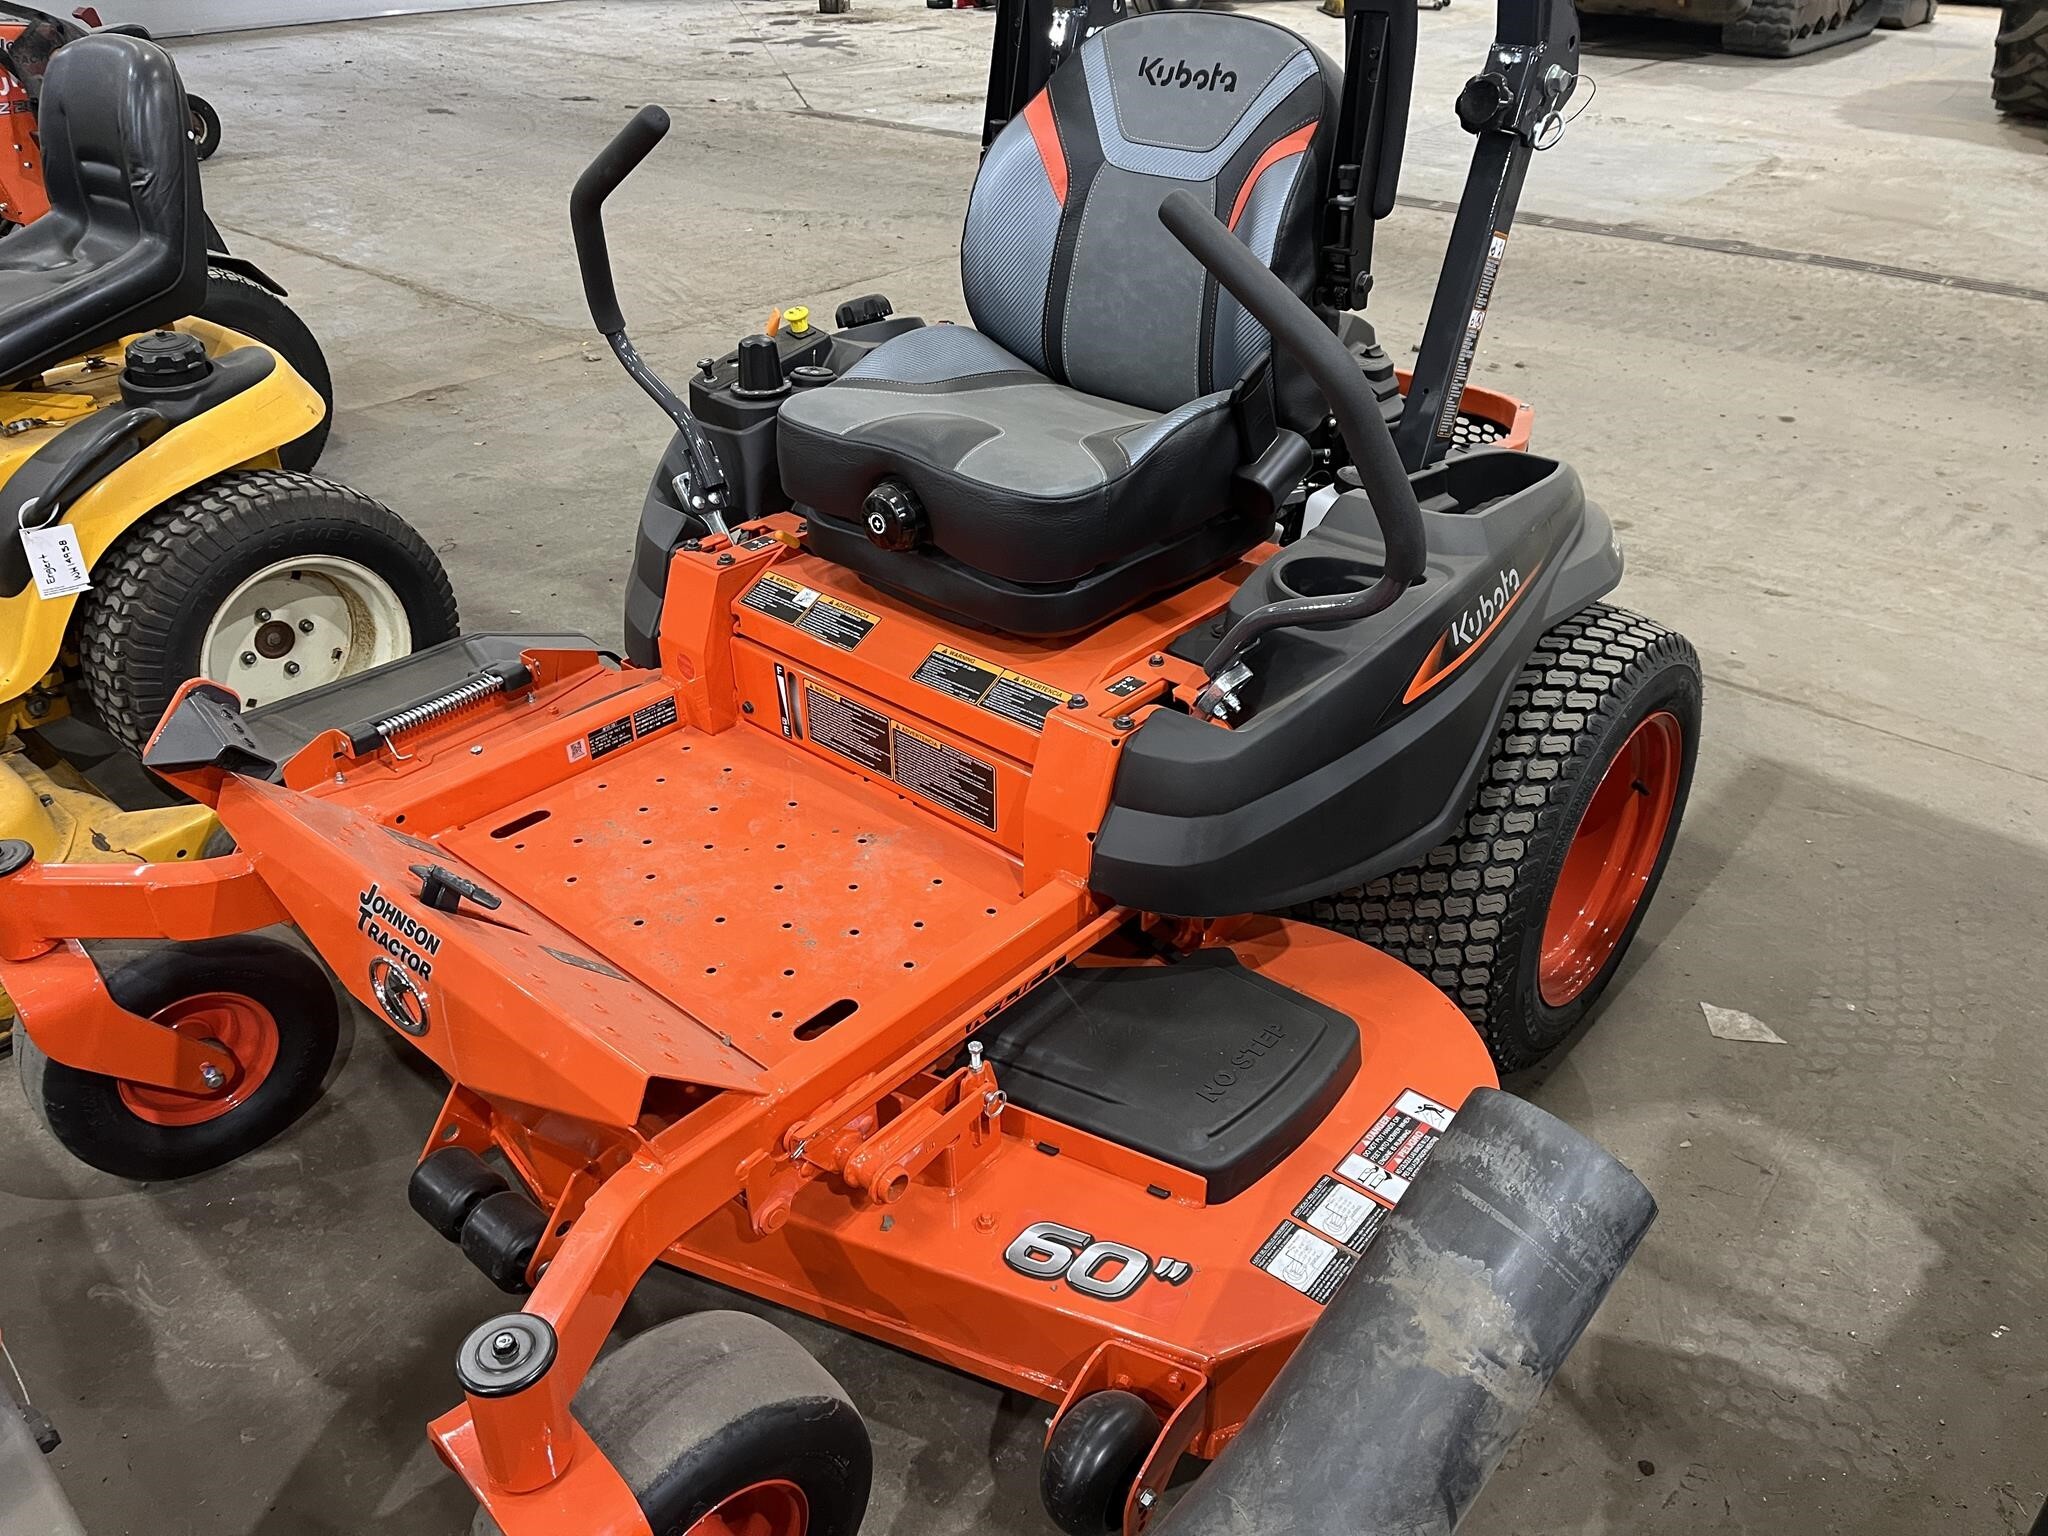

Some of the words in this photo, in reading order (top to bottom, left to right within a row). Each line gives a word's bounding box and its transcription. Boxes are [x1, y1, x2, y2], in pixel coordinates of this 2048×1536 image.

[1138, 56, 1238, 93] Kubota
[774, 576, 799, 589] WARNING
[835, 601, 870, 619] ADVERTENCIA
[1451, 567, 1520, 646] Kubota
[776, 665, 783, 675] F
[949, 651, 976, 664] WARNING
[814, 686, 838, 701] WARNING
[1020, 678, 1063, 698] ADVERTENCIA
[901, 726, 939, 747] ADVERTENCIA
[359, 882, 441, 956] JOHNSON
[357, 907, 433, 982] TRACTOR
[1195, 1069, 1237, 1103] NO
[1230, 1022, 1288, 1070] STEP
[1361, 1149, 1371, 1157] DO
[1366, 1141, 1378, 1151] NOT
[1374, 1134, 1385, 1143] PUT
[1380, 1121, 1396, 1136] HANDS
[1366, 1115, 1391, 1142] DANGER
[1369, 1150, 1382, 1161] FEET
[1399, 1131, 1423, 1158] PELIGRO
[1003, 1220, 1194, 1302] 60"
